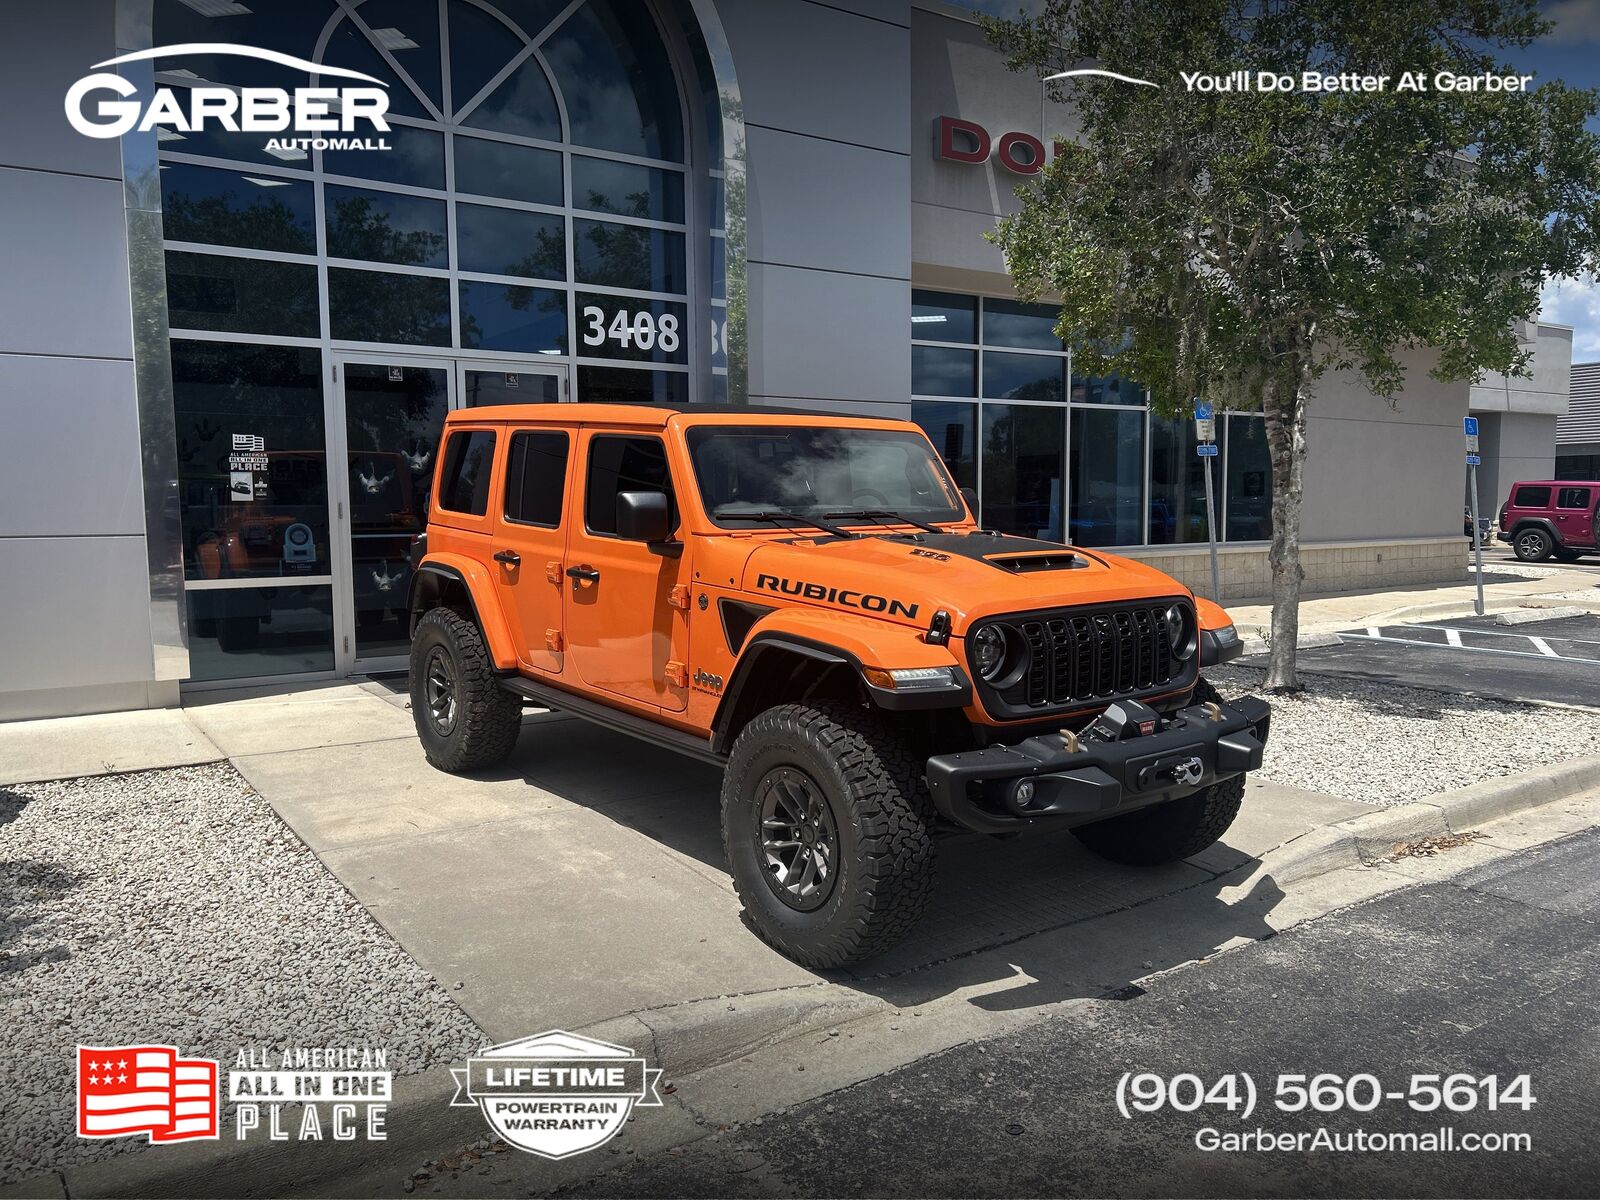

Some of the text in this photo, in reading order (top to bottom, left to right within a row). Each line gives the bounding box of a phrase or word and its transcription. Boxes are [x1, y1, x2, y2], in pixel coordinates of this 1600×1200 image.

[934, 115, 1075, 176] DO
[583, 305, 680, 352] 3408
[230, 462, 268, 471] PLACE
[756, 573, 919, 620] RUBICON
[693, 667, 723, 692] Jeep
